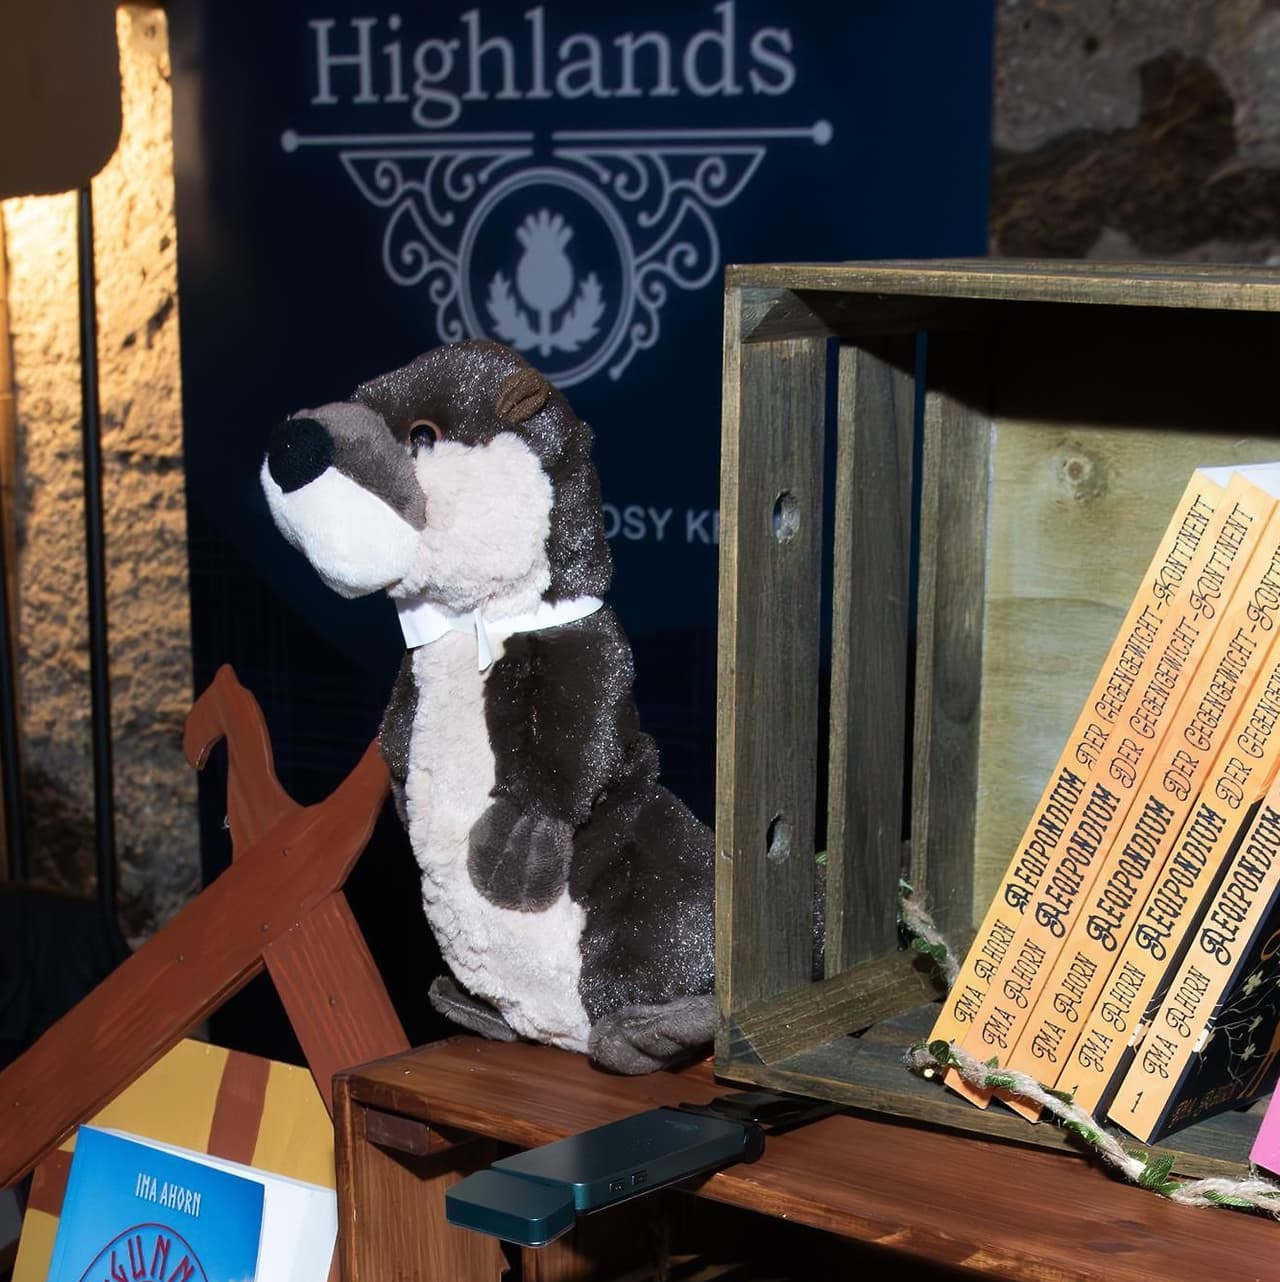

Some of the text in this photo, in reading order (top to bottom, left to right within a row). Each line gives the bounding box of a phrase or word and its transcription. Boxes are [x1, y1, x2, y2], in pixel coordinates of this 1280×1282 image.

[308, 5, 797, 127] Highlands
[602, 503, 673, 541] OSY
[136, 1172, 201, 1218] IMA AHORN
